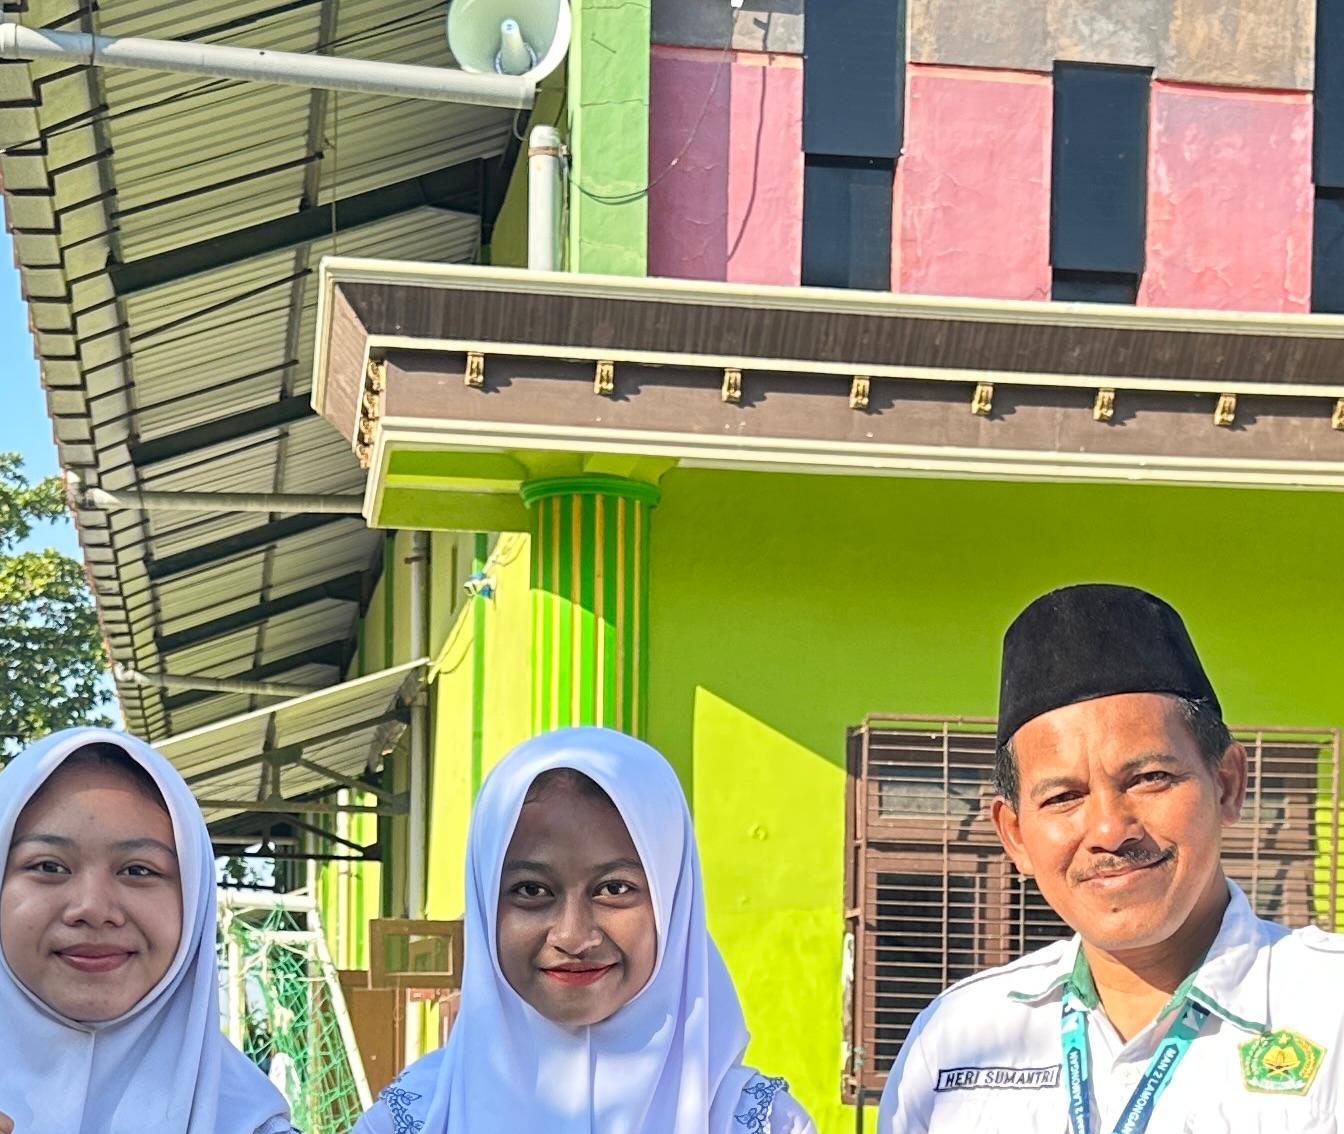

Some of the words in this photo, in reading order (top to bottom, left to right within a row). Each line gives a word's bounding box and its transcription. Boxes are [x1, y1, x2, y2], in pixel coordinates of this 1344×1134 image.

[1157, 1048, 1177, 1071] MAN
[945, 1070, 980, 1087] HERI
[984, 1068, 1054, 1085] SUMANTRI
[1069, 1051, 1082, 1106] LAMONGAN
[1153, 1070, 1162, 1078] 2
